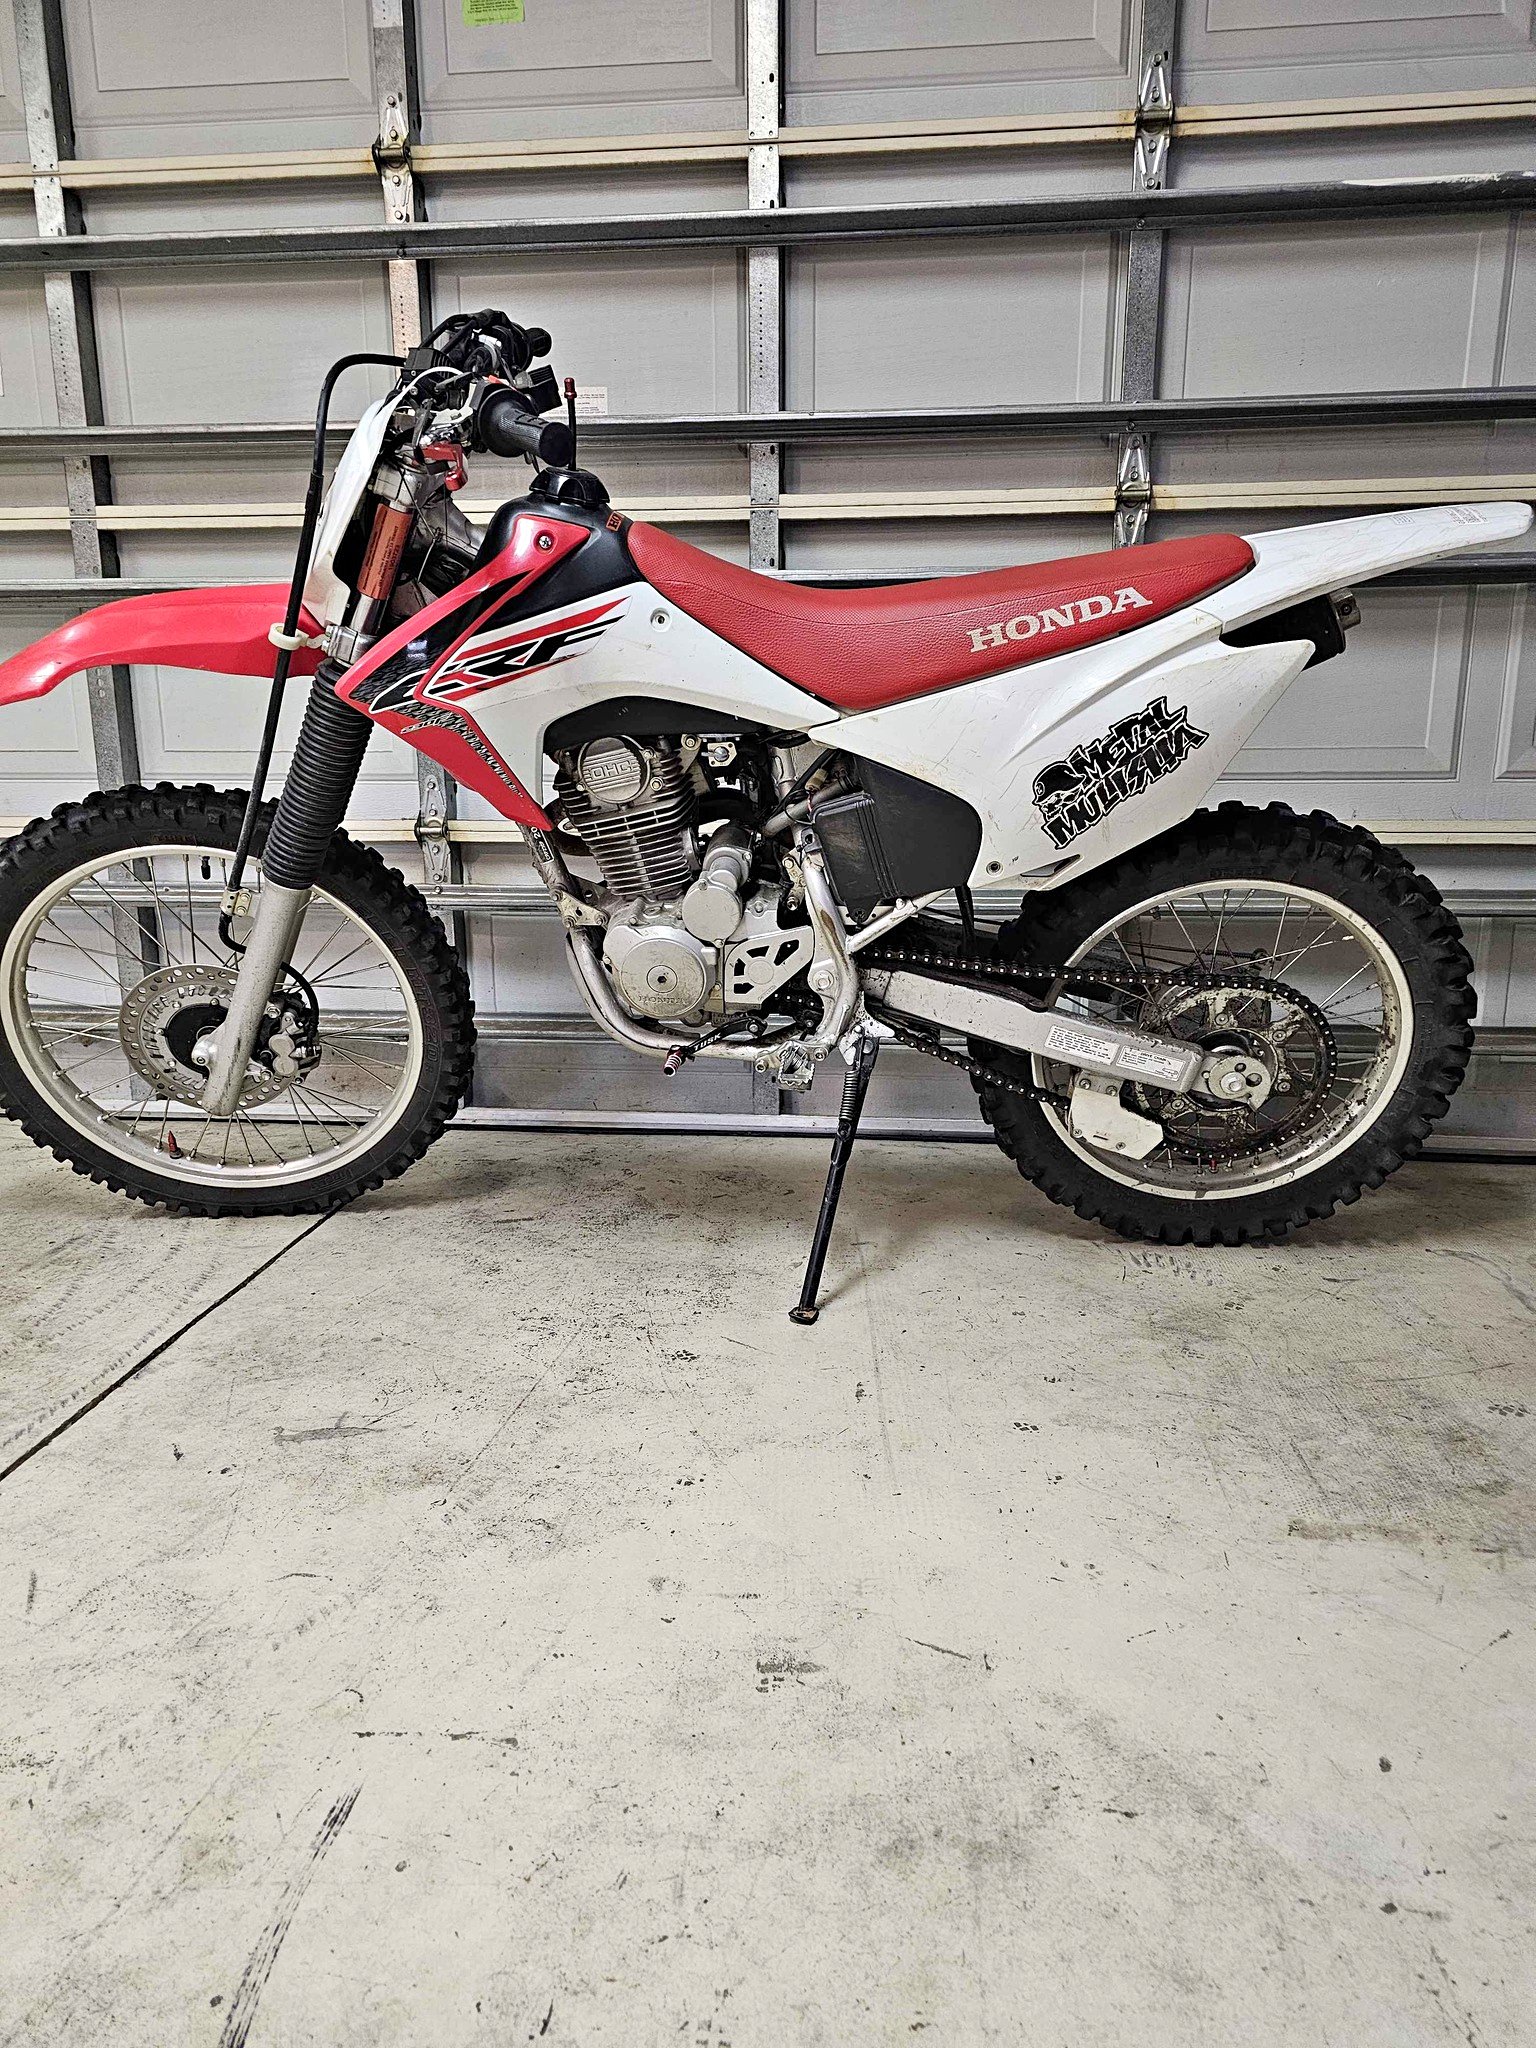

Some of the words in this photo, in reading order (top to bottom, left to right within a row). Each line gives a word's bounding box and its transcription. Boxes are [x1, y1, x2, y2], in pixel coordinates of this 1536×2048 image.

[966, 586, 1153, 653] HONDA
[1067, 696, 1188, 791] METAL
[592, 760, 632, 780] OHC
[693, 1032, 721, 1051] TUSK
